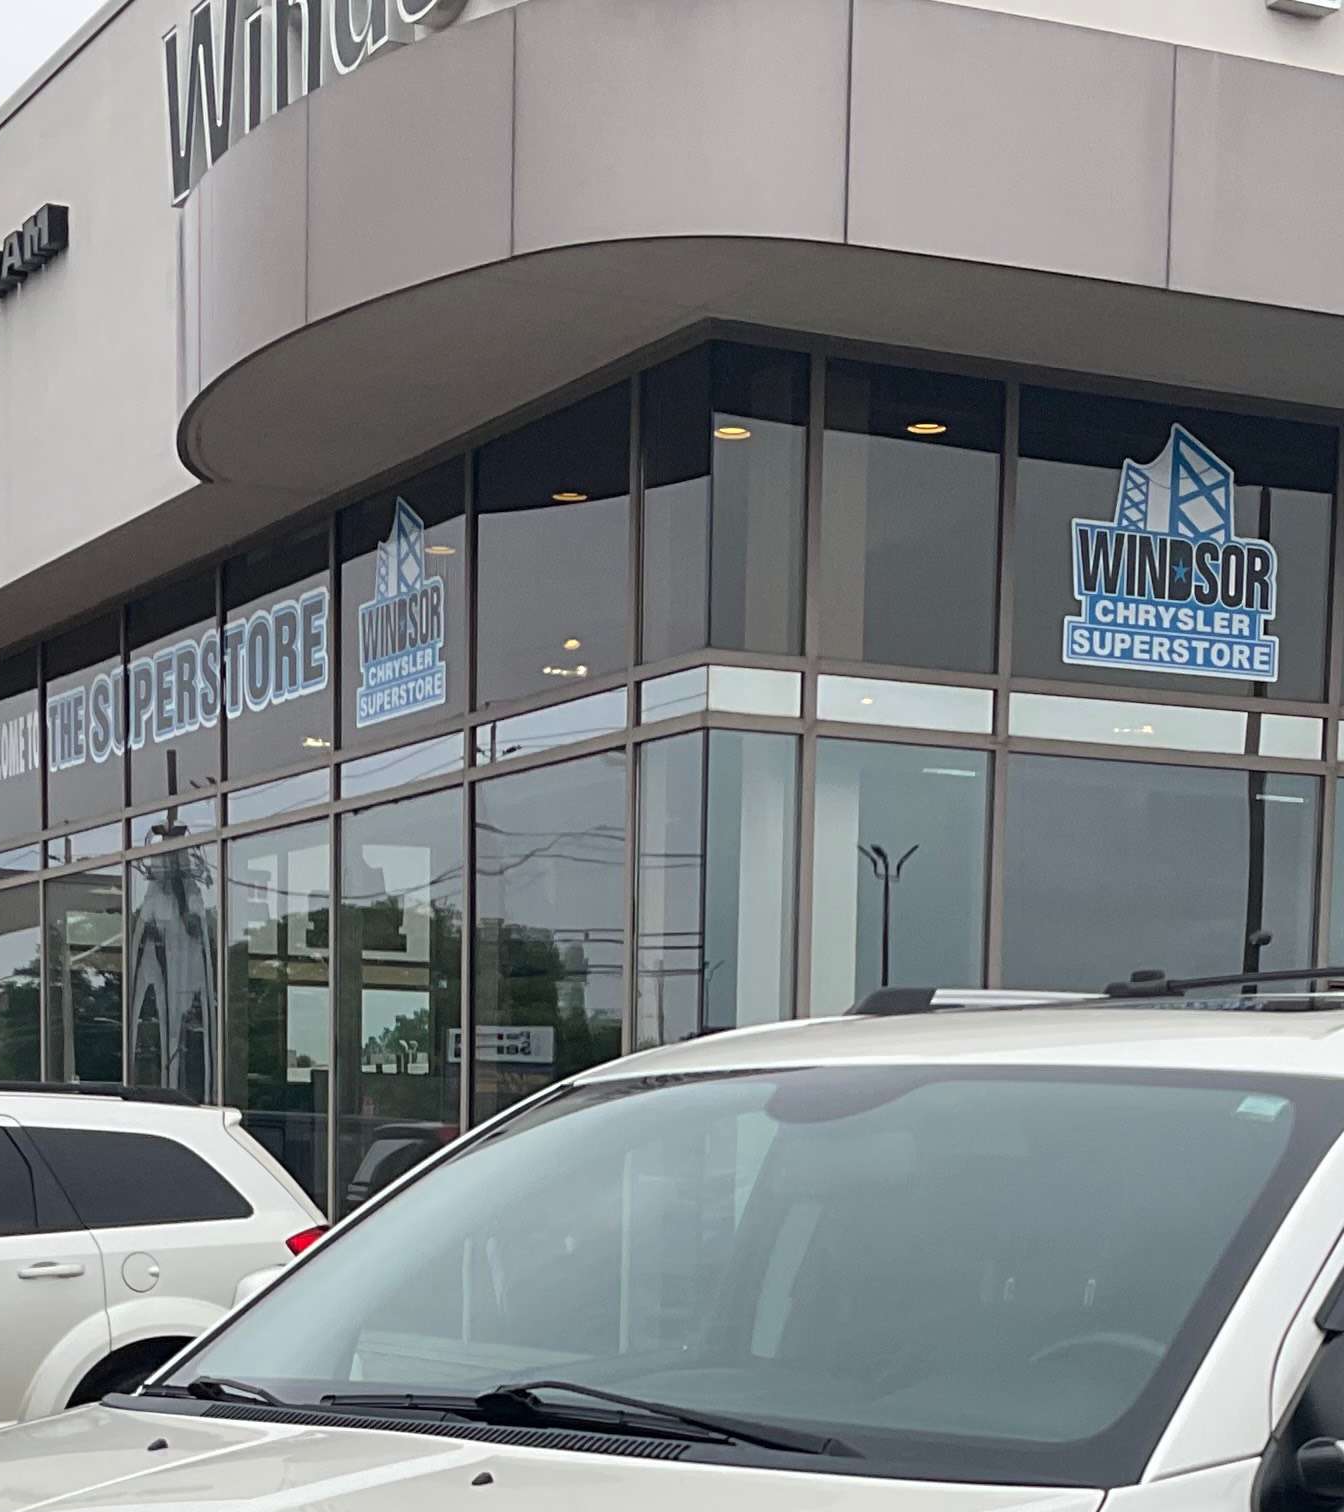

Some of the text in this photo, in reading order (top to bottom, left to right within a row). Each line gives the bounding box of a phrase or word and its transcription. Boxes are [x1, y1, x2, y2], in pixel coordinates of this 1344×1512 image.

[1077, 528, 1272, 611] WINDSOR
[362, 585, 441, 663] WINDSOR
[1095, 600, 1251, 636] CHRYSLER
[368, 648, 433, 686] CHRYSLER
[1071, 629, 1271, 672] SUPERSTORE
[47, 592, 328, 770] THE SUPERSTORE
[360, 672, 443, 717] SUPERSTORE
[26, 708, 40, 771] TO
